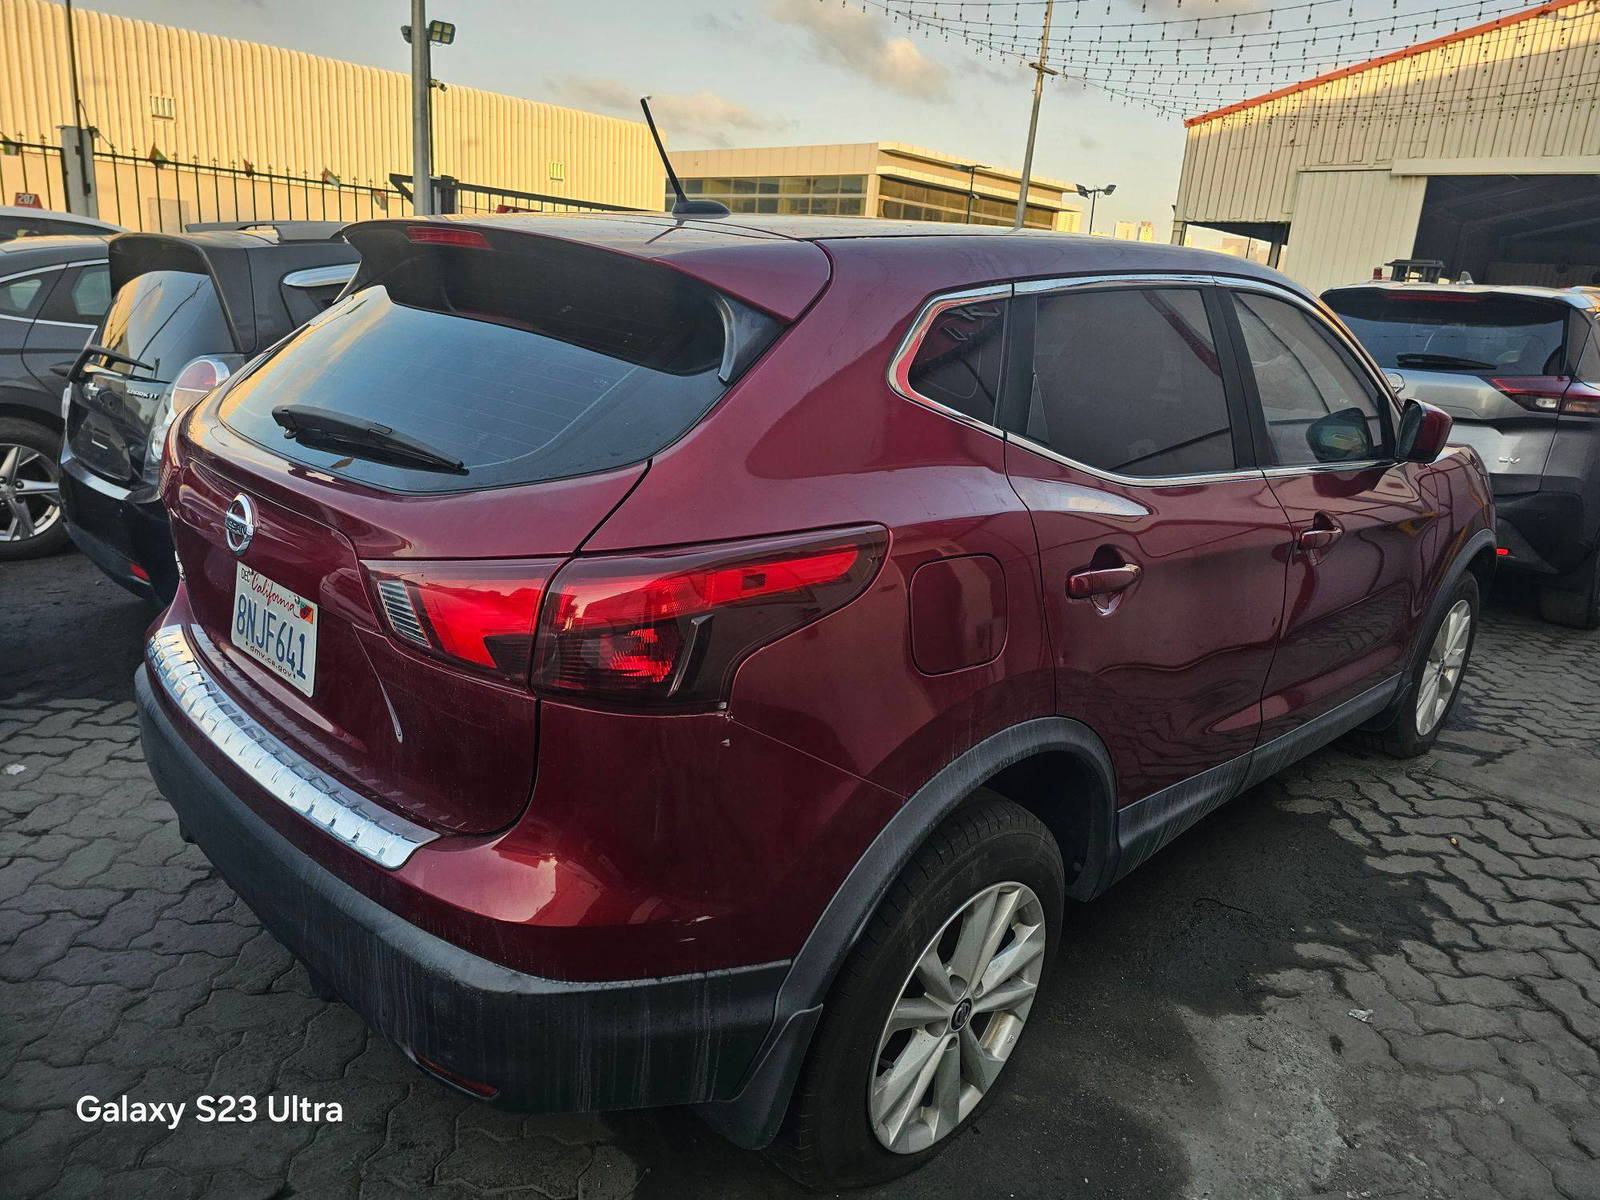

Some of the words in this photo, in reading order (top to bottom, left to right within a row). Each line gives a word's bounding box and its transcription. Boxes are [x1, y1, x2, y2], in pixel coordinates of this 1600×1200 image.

[251, 571, 299, 619] California
[236, 593, 307, 681] 8NJF641
[249, 644, 293, 677] dmv.ca.gov
